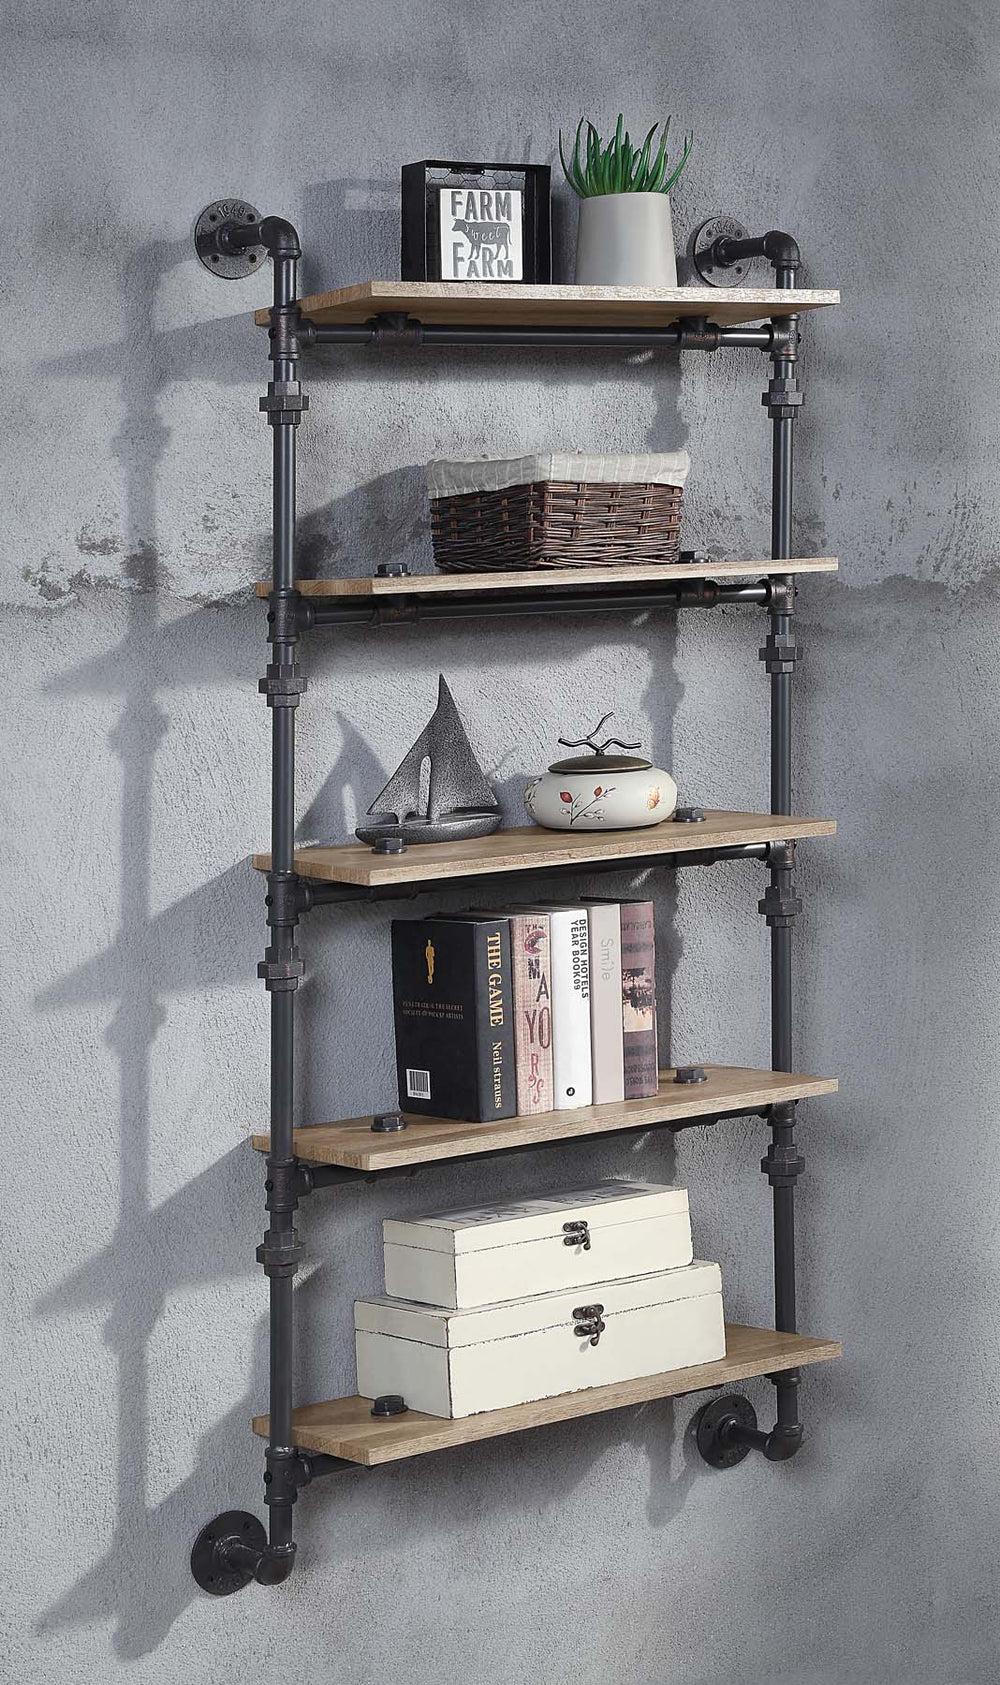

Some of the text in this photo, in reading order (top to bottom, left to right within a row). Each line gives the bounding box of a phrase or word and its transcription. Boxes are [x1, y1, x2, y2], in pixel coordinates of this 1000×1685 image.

[451, 191, 512, 221] FARM
[452, 242, 514, 278] FARM
[571, 920, 579, 946] YEAR
[486, 932, 504, 1027] THE GAME
[579, 919, 589, 999] DESIGN HOTELS
[600, 937, 614, 981] Smile
[492, 1042, 503, 1109] Neil strauss
